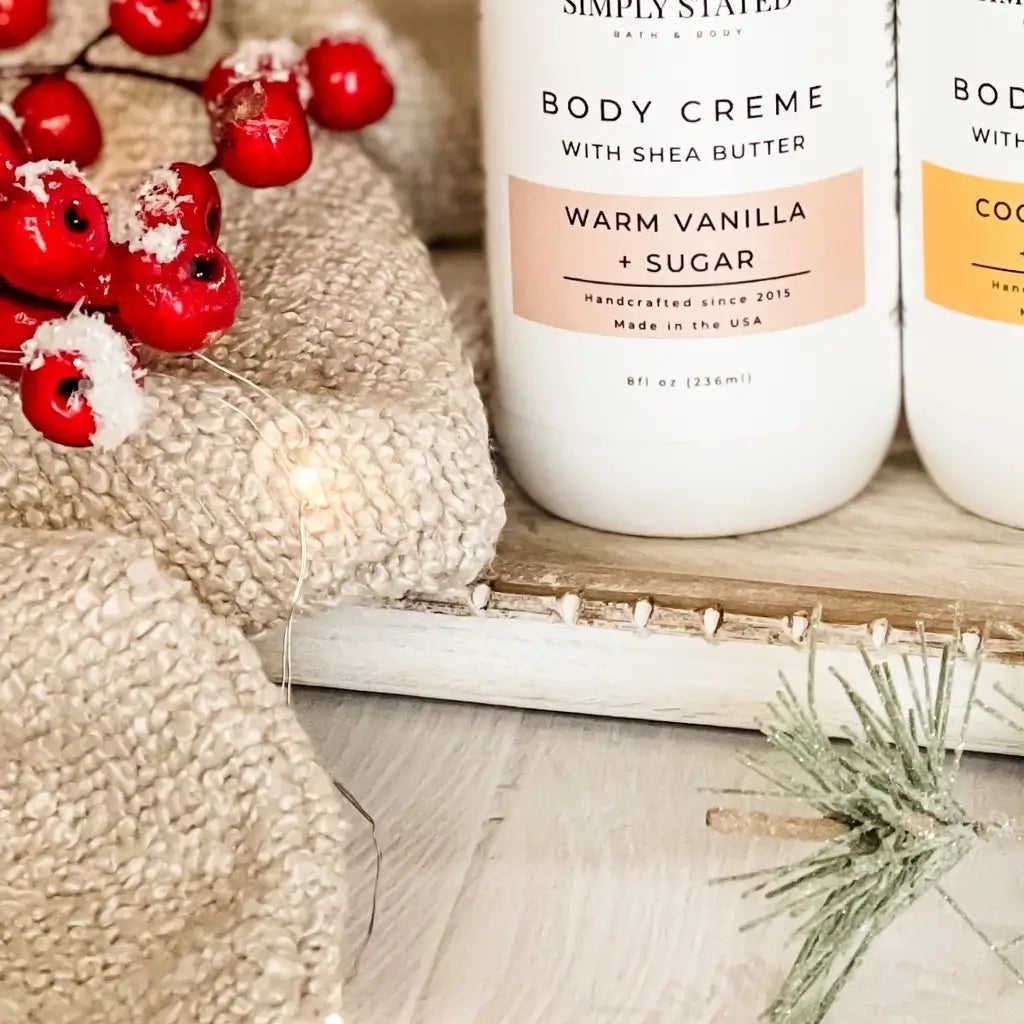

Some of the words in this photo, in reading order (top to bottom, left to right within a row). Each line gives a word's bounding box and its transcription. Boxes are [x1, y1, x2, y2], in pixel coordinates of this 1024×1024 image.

[613, 30, 658, 39] BATH
[673, 31, 681, 39] &
[696, 28, 743, 39] BODY
[542, 90, 652, 124] BODY
[680, 84, 823, 124] CREME
[561, 139, 621, 162] WITH
[632, 146, 701, 163] SHEA
[713, 134, 805, 161] BUTTER
[564, 205, 659, 233] WARM
[673, 201, 807, 233] VANILLA
[619, 256, 631, 268] +
[646, 249, 754, 273] SUGAR
[584, 293, 692, 308] Handcrafted
[701, 296, 748, 307] since
[756, 288, 791, 303] 2015
[614, 319, 658, 331] Made
[667, 320, 683, 331] in
[692, 320, 720, 331] the
[730, 315, 762, 328] USA
[626, 376, 649, 387] 8fl
[658, 379, 677, 388] oz
[686, 373, 752, 389] (236ml)
